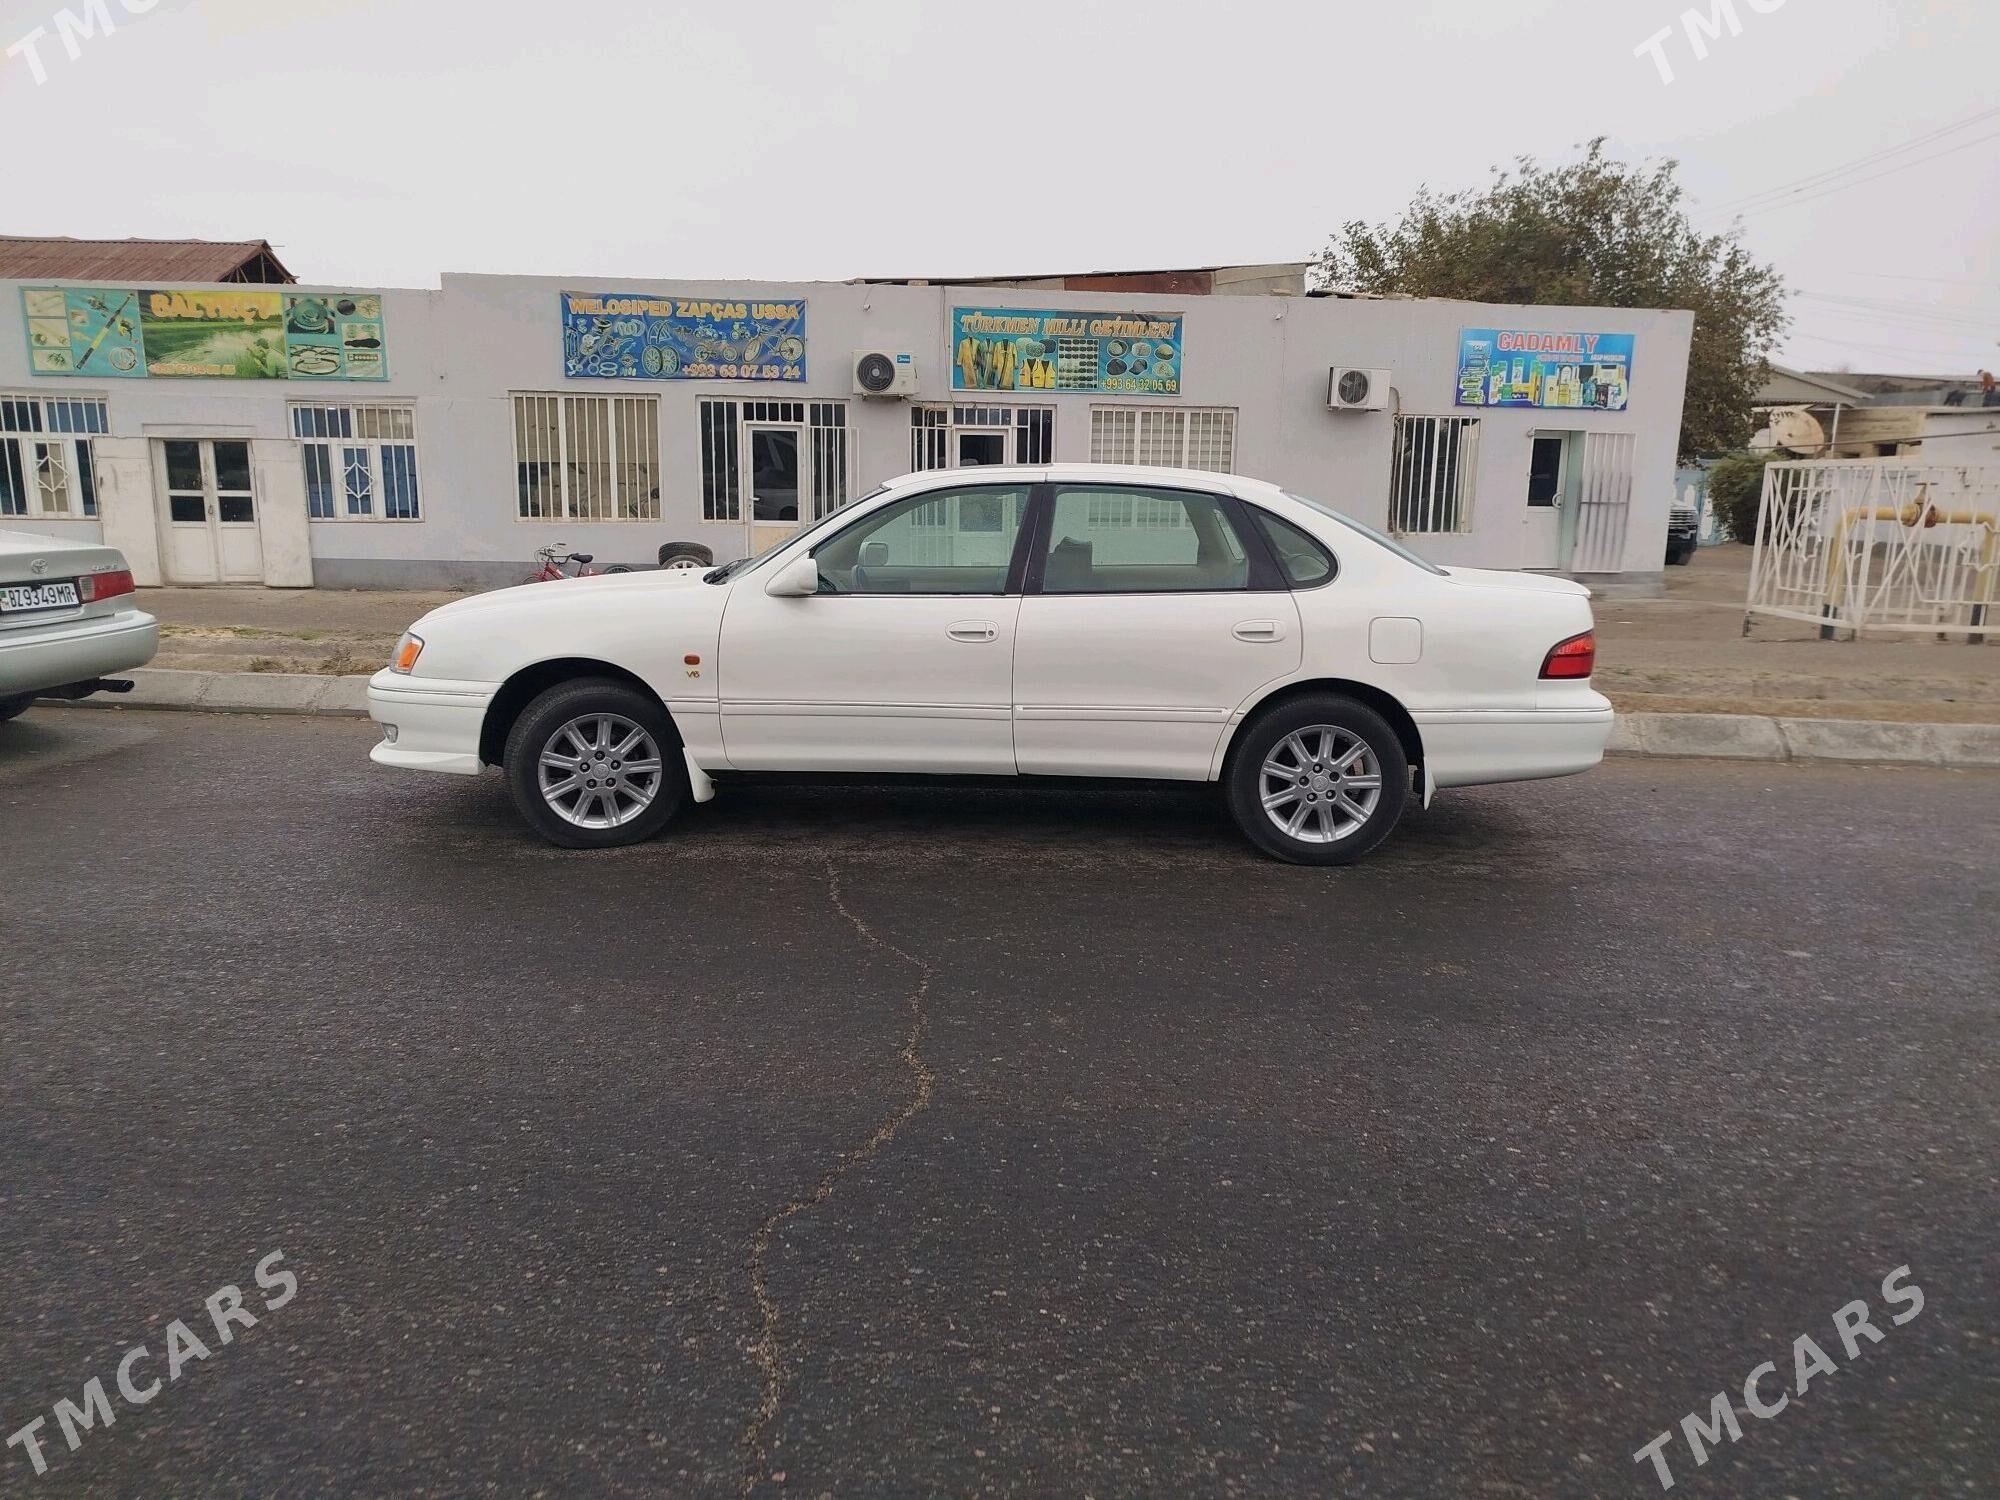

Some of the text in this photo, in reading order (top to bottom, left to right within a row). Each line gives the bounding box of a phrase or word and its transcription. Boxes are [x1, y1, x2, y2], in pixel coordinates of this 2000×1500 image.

[569, 299, 799, 321] WELOSIPED ZAPÇAS USSA
[961, 311, 1040, 335] TÜRKMEN
[1042, 318, 1087, 336] MILLI
[682, 363, 717, 377] +993
[740, 364, 759, 378] 07
[782, 365, 800, 378] 24
[1101, 378, 1123, 390] +993
[1125, 379, 1137, 391] 64
[1139, 379, 1151, 391] 32
[1165, 380, 1177, 392] 69
